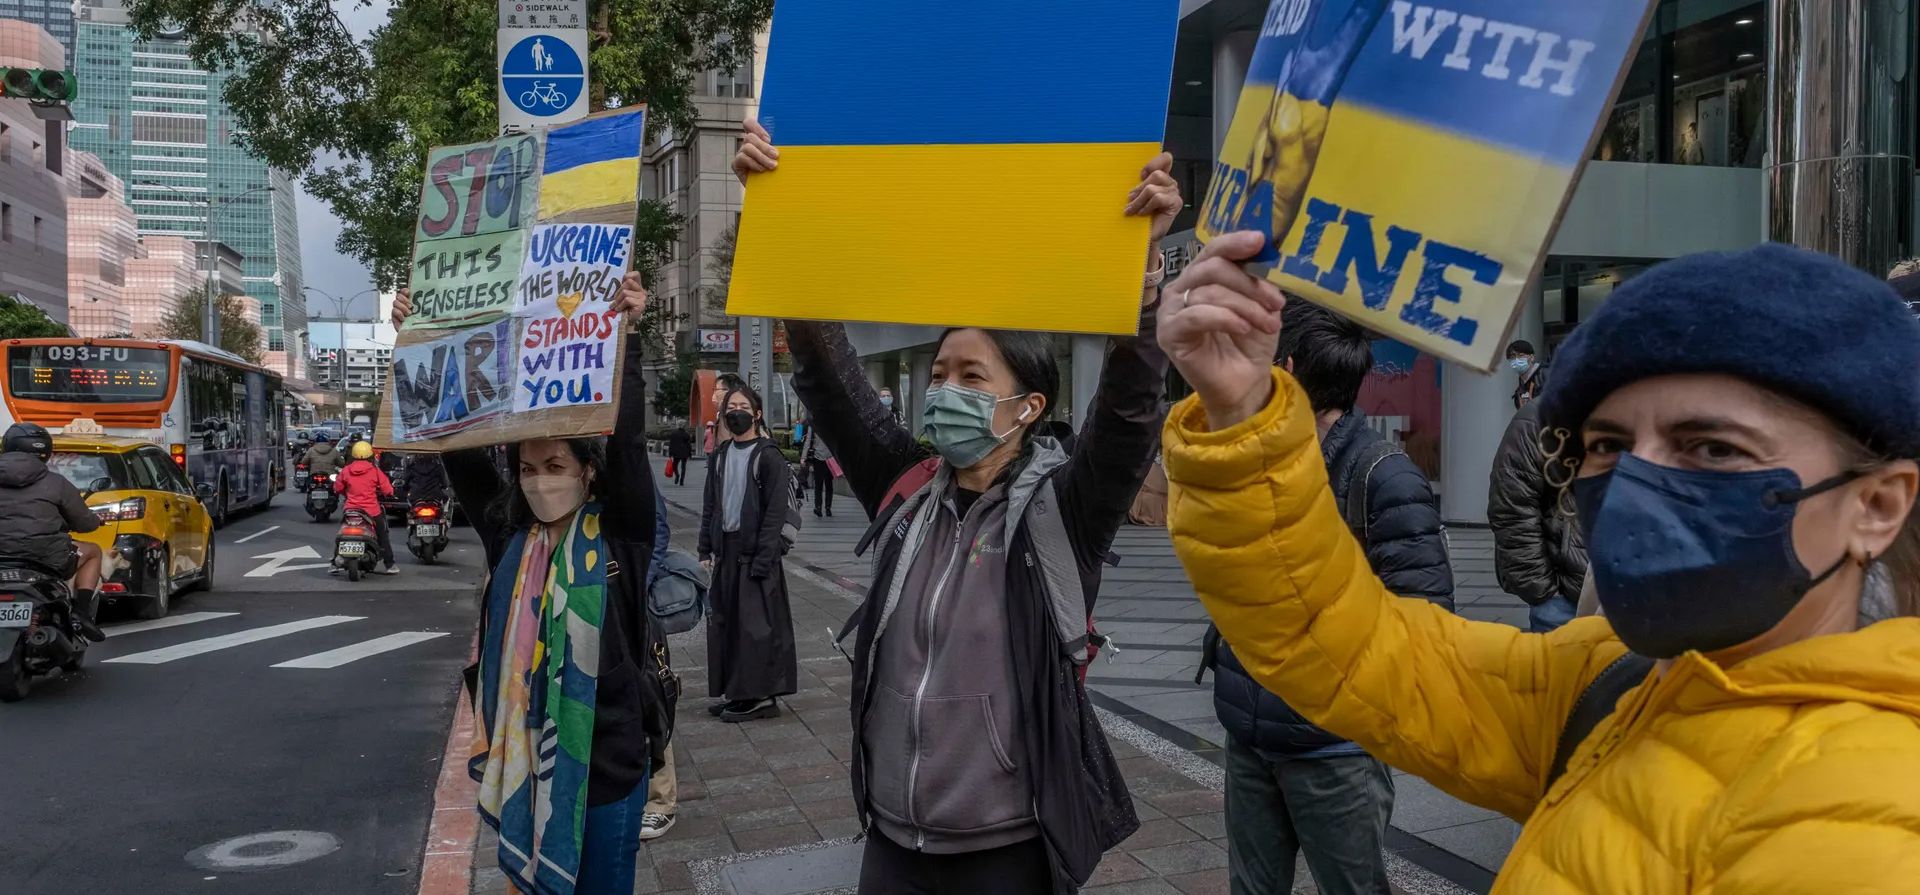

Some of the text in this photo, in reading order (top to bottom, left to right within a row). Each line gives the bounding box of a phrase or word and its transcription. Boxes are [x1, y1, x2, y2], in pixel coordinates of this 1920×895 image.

[1389, 1, 1595, 96] WITH
[421, 136, 540, 237] STOP
[417, 244, 502, 280] THIS
[412, 279, 514, 318] SENSELESS
[519, 266, 621, 307] THE WORLD
[524, 310, 619, 349] STANDS
[48, 346, 129, 361] 093-FU
[394, 316, 511, 428] WAR!
[523, 343, 604, 375] WITH
[522, 374, 603, 408] YOU.
